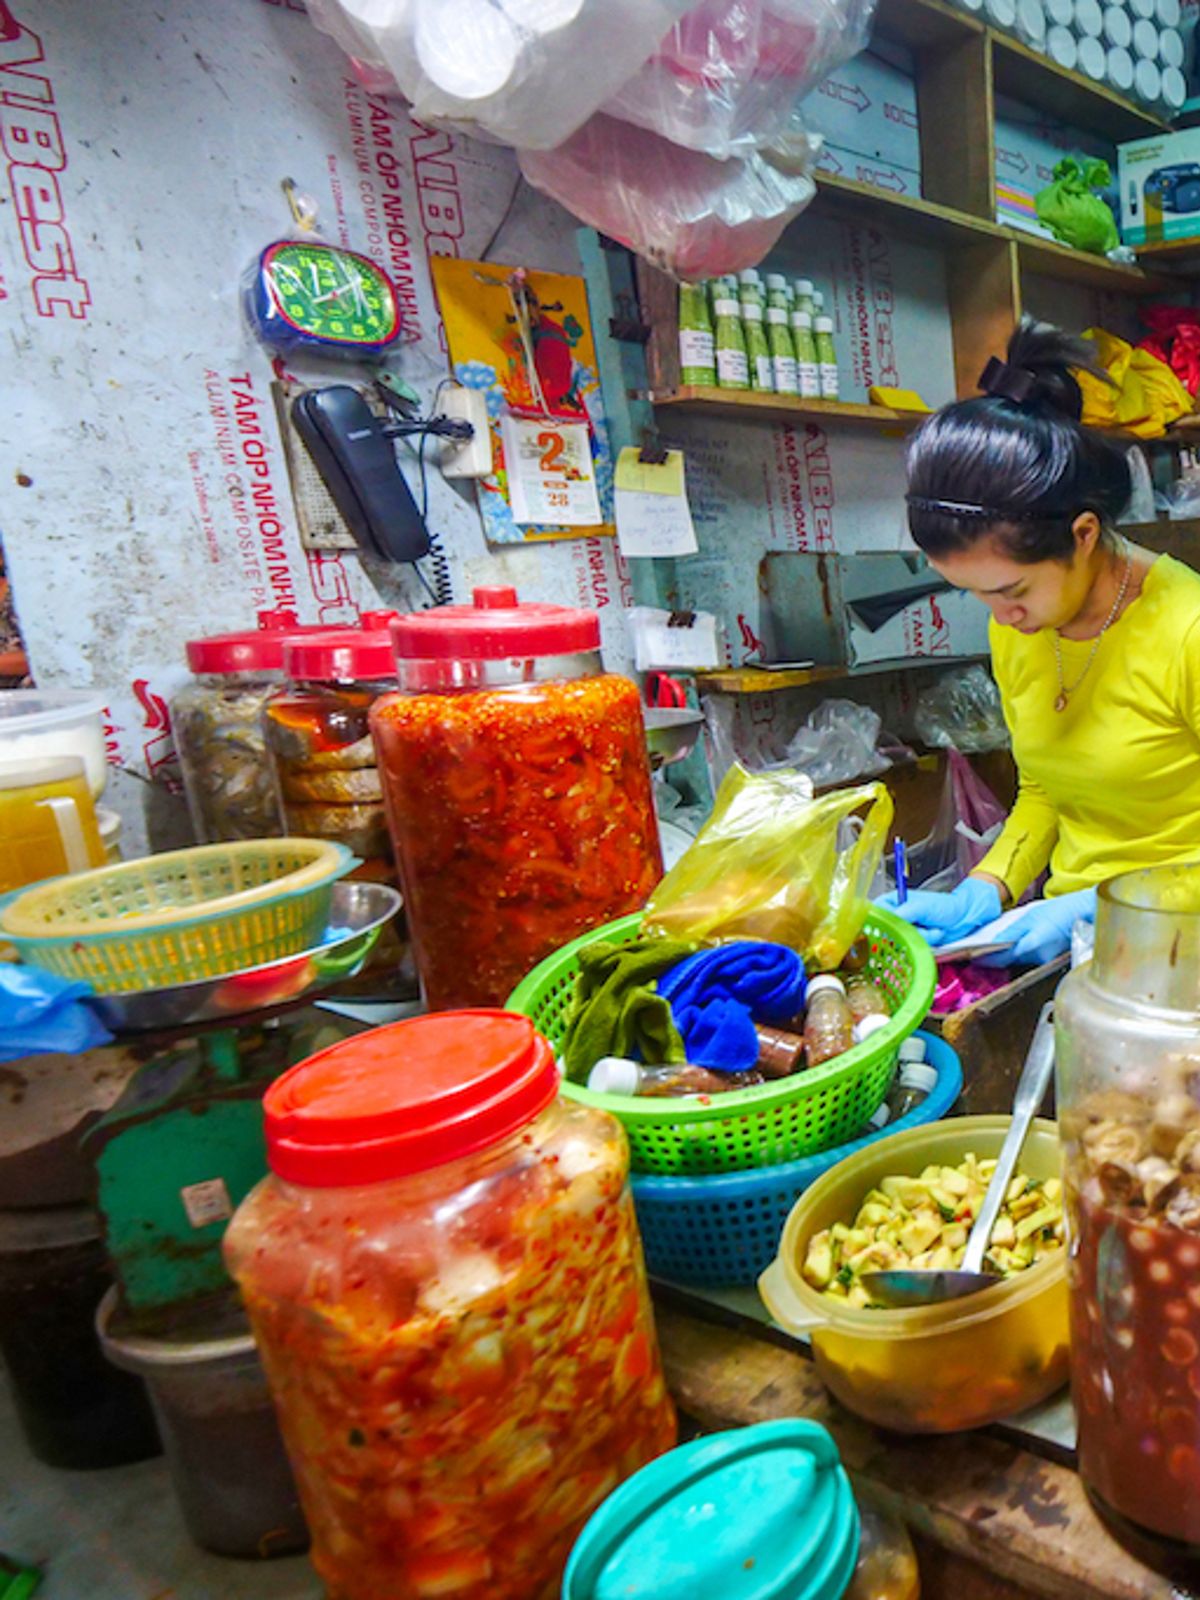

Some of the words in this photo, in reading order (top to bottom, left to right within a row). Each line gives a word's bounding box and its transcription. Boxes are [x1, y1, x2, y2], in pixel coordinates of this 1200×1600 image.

[229, 371, 265, 435] TẤM
[204, 369, 237, 467] ALUMINUM
[224, 472, 263, 583] COMPOSITE
[242, 438, 274, 477] ỐP
[537, 432, 569, 472] 2
[251, 481, 288, 561] NHÔM
